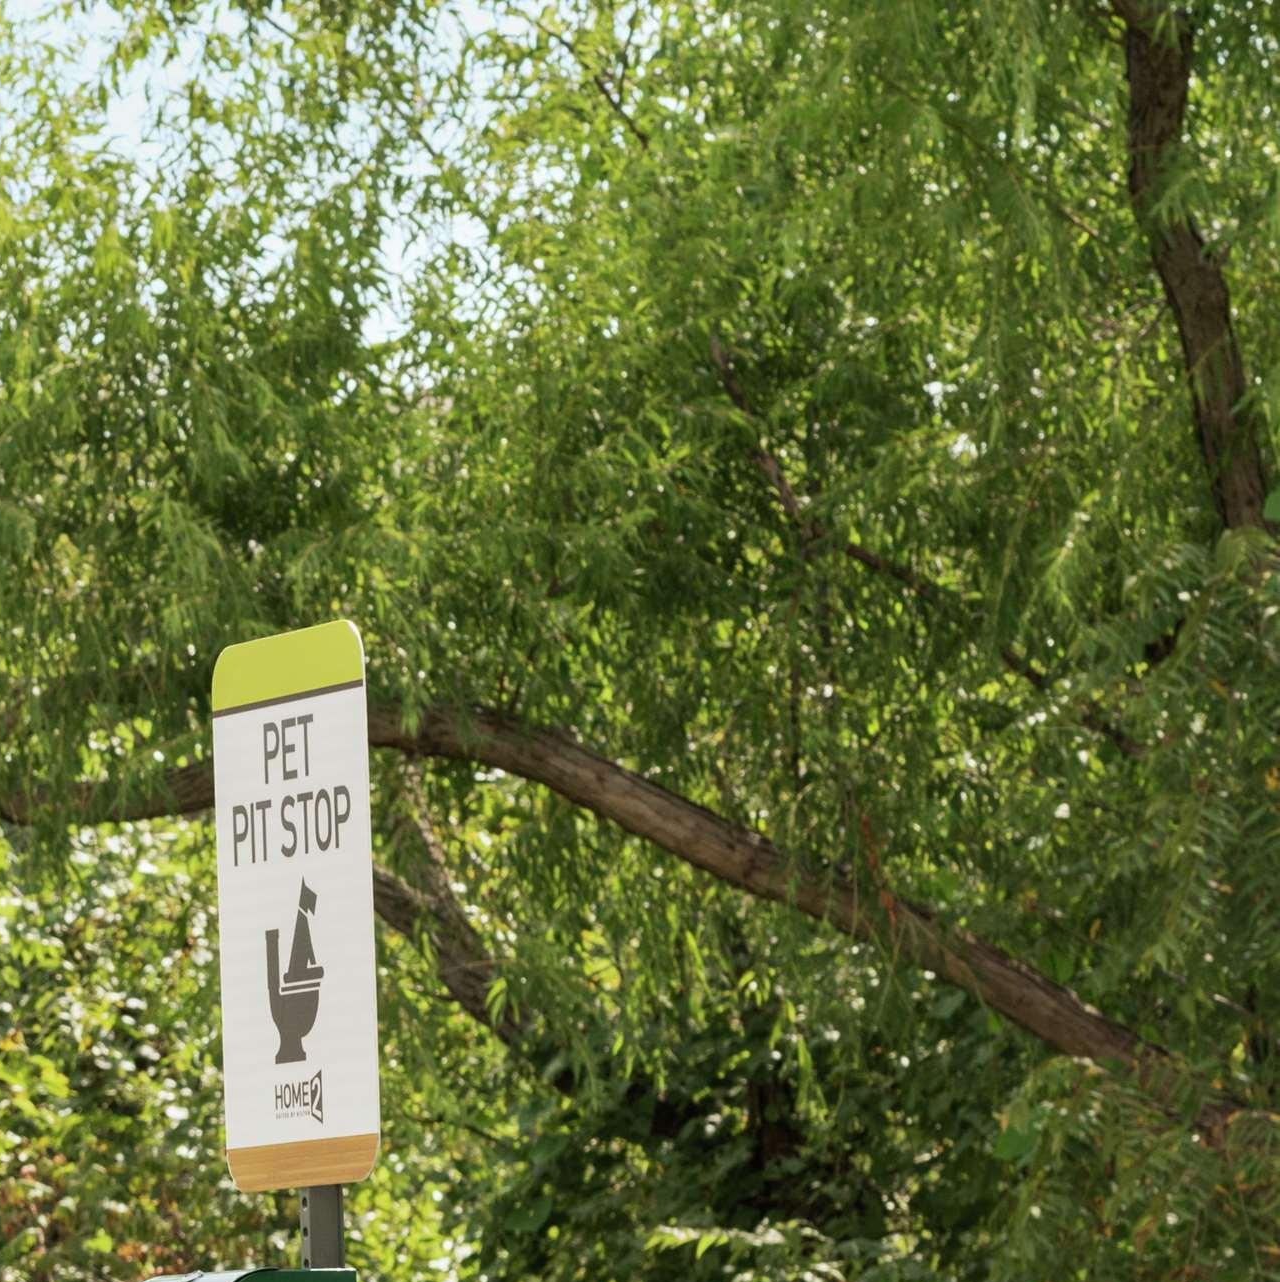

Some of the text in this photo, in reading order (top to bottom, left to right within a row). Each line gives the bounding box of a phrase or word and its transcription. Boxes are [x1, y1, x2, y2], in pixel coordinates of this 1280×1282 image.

[263, 714, 314, 784] PET
[232, 785, 351, 867] PIT STOP
